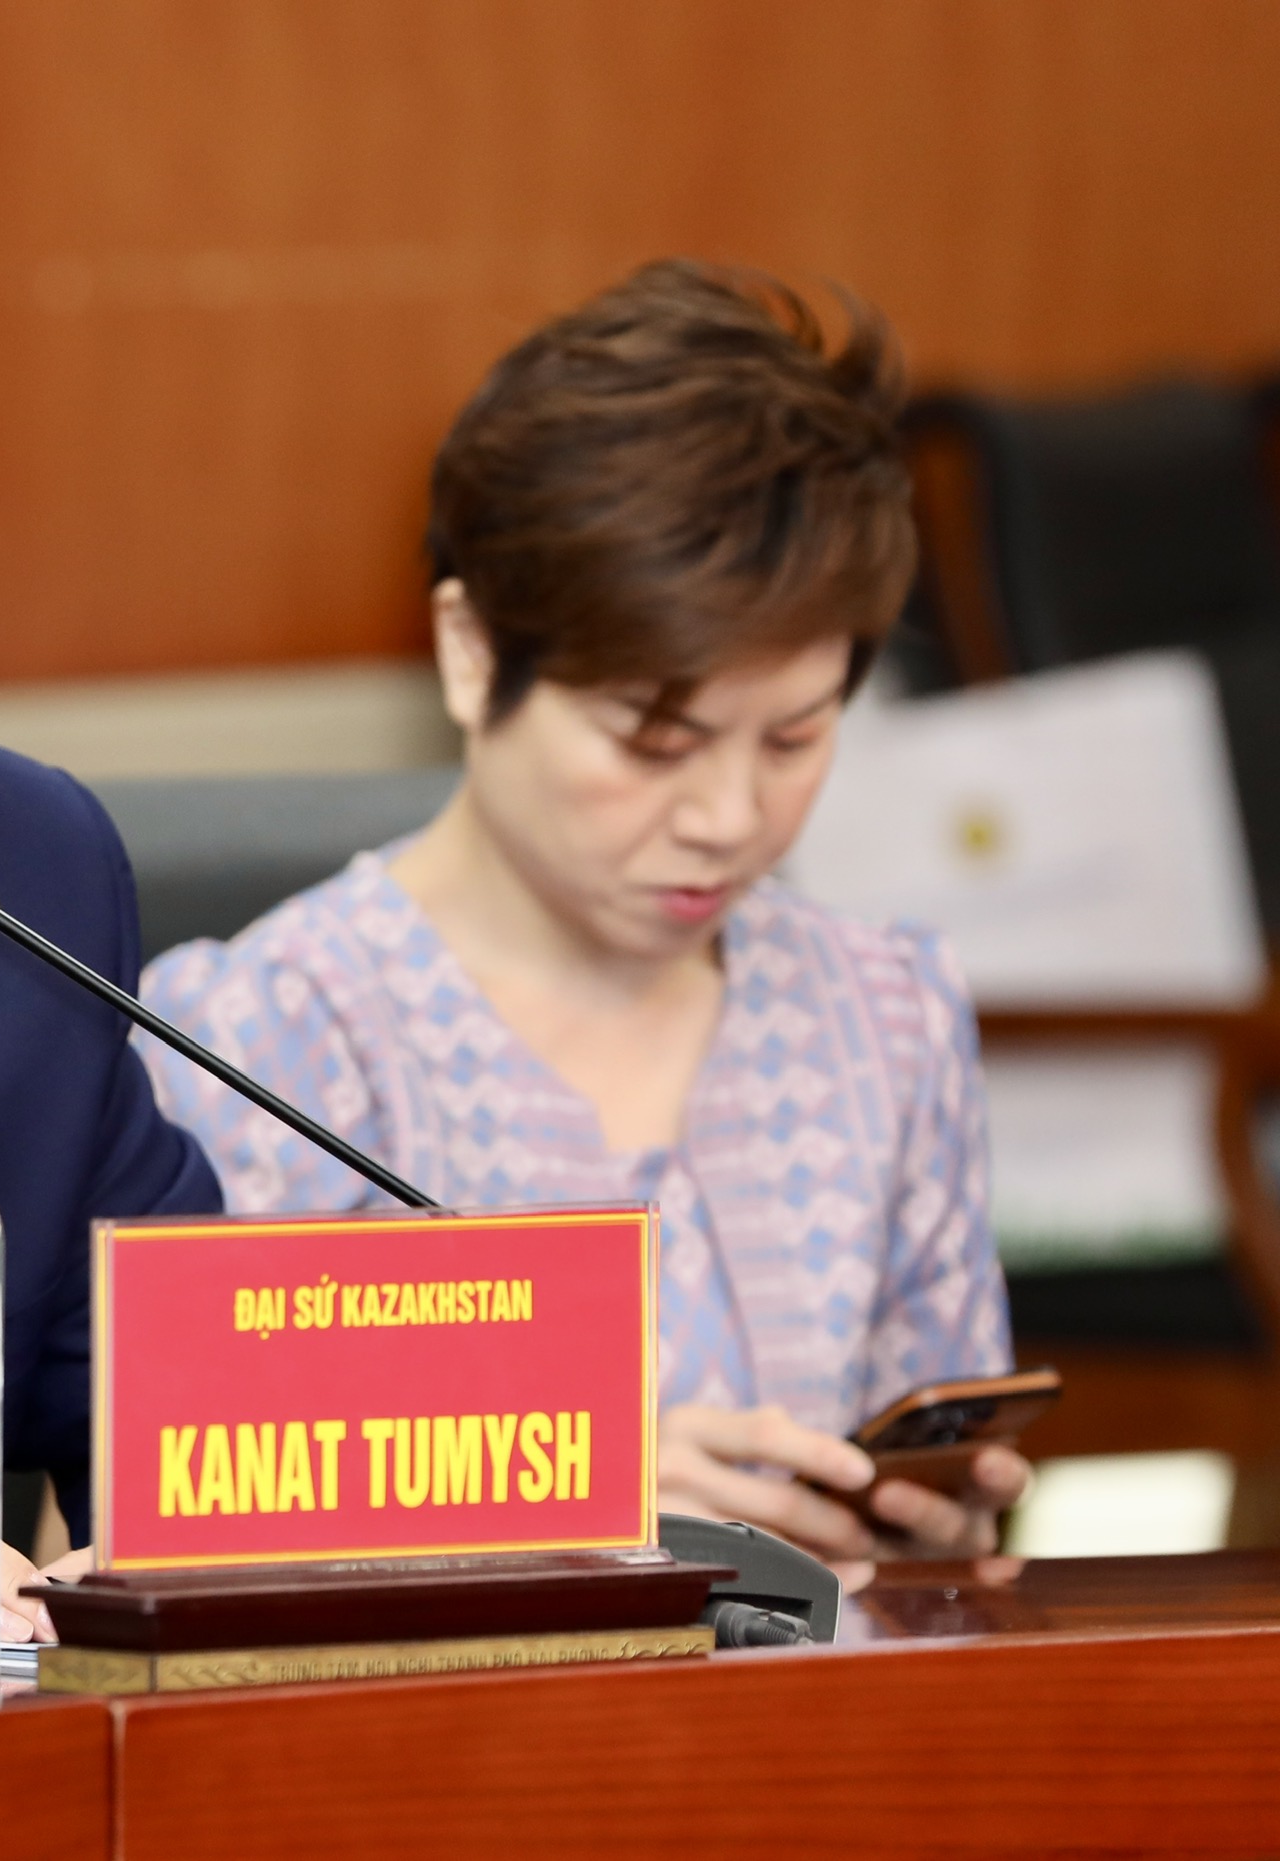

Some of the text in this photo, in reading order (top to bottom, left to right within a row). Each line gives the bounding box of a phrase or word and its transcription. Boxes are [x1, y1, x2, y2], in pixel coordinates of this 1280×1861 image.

[234, 1274, 532, 1340] ĐẠI SỨ KAZAKHSTAN
[159, 1411, 591, 1517] KANAT TUMYSH
